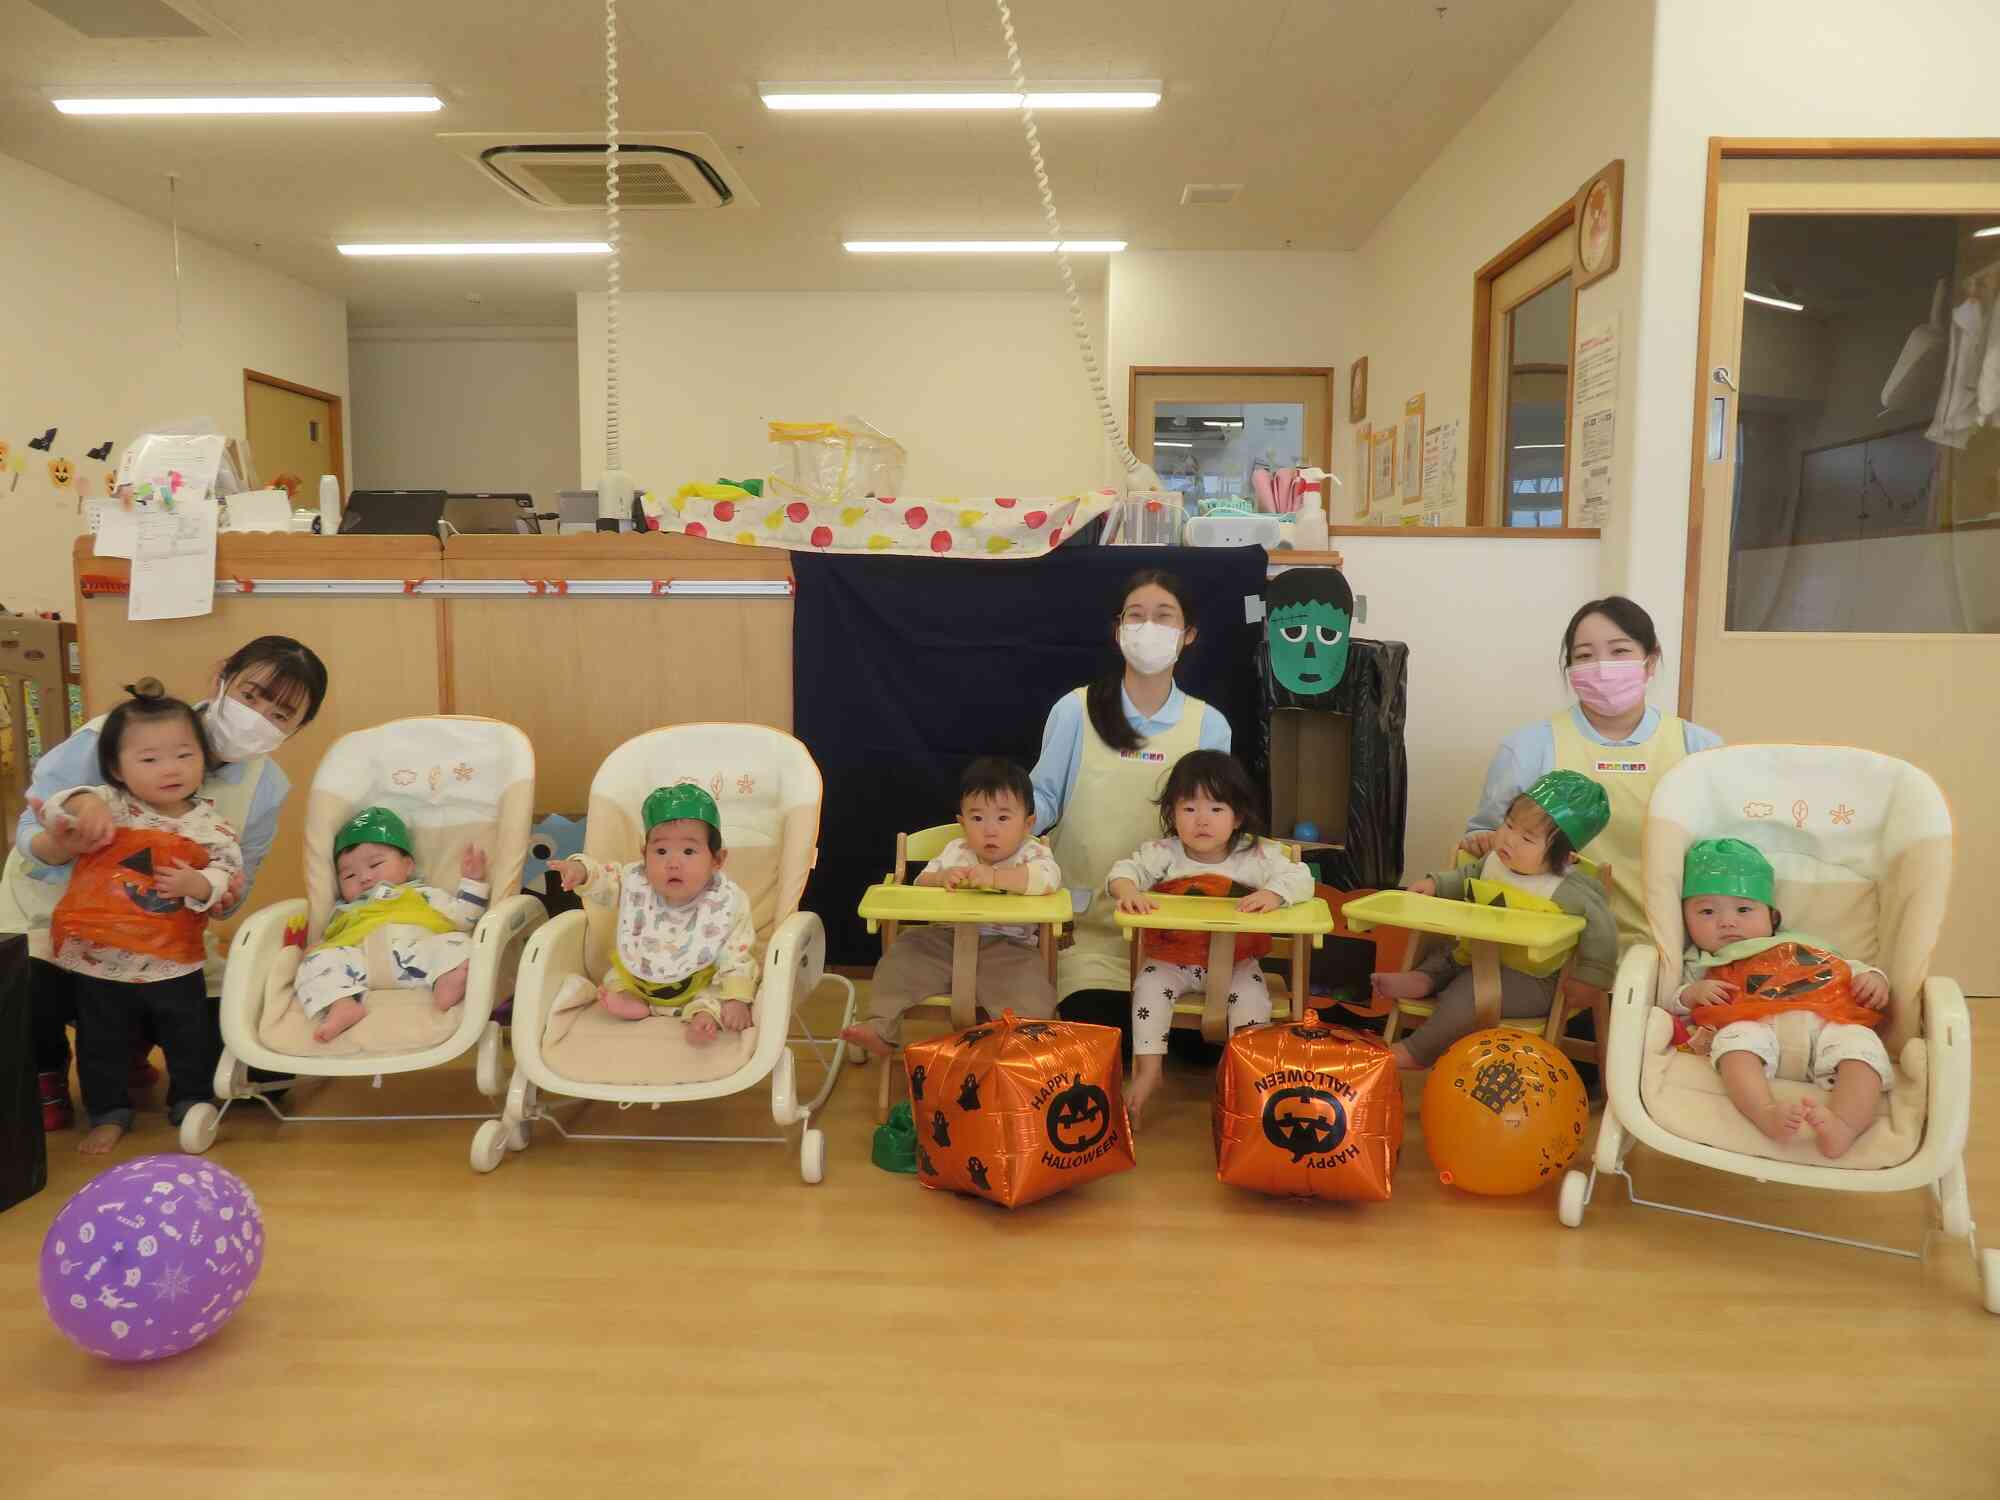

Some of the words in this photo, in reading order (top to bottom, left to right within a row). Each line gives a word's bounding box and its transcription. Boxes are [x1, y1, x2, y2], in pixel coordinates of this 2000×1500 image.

[1031, 1072, 1069, 1110] HAPPY
[1255, 1071, 1357, 1101] HALLOWEEN
[1042, 1131, 1118, 1168] HALLOWEEN
[1307, 1145, 1360, 1168] HAPPY
